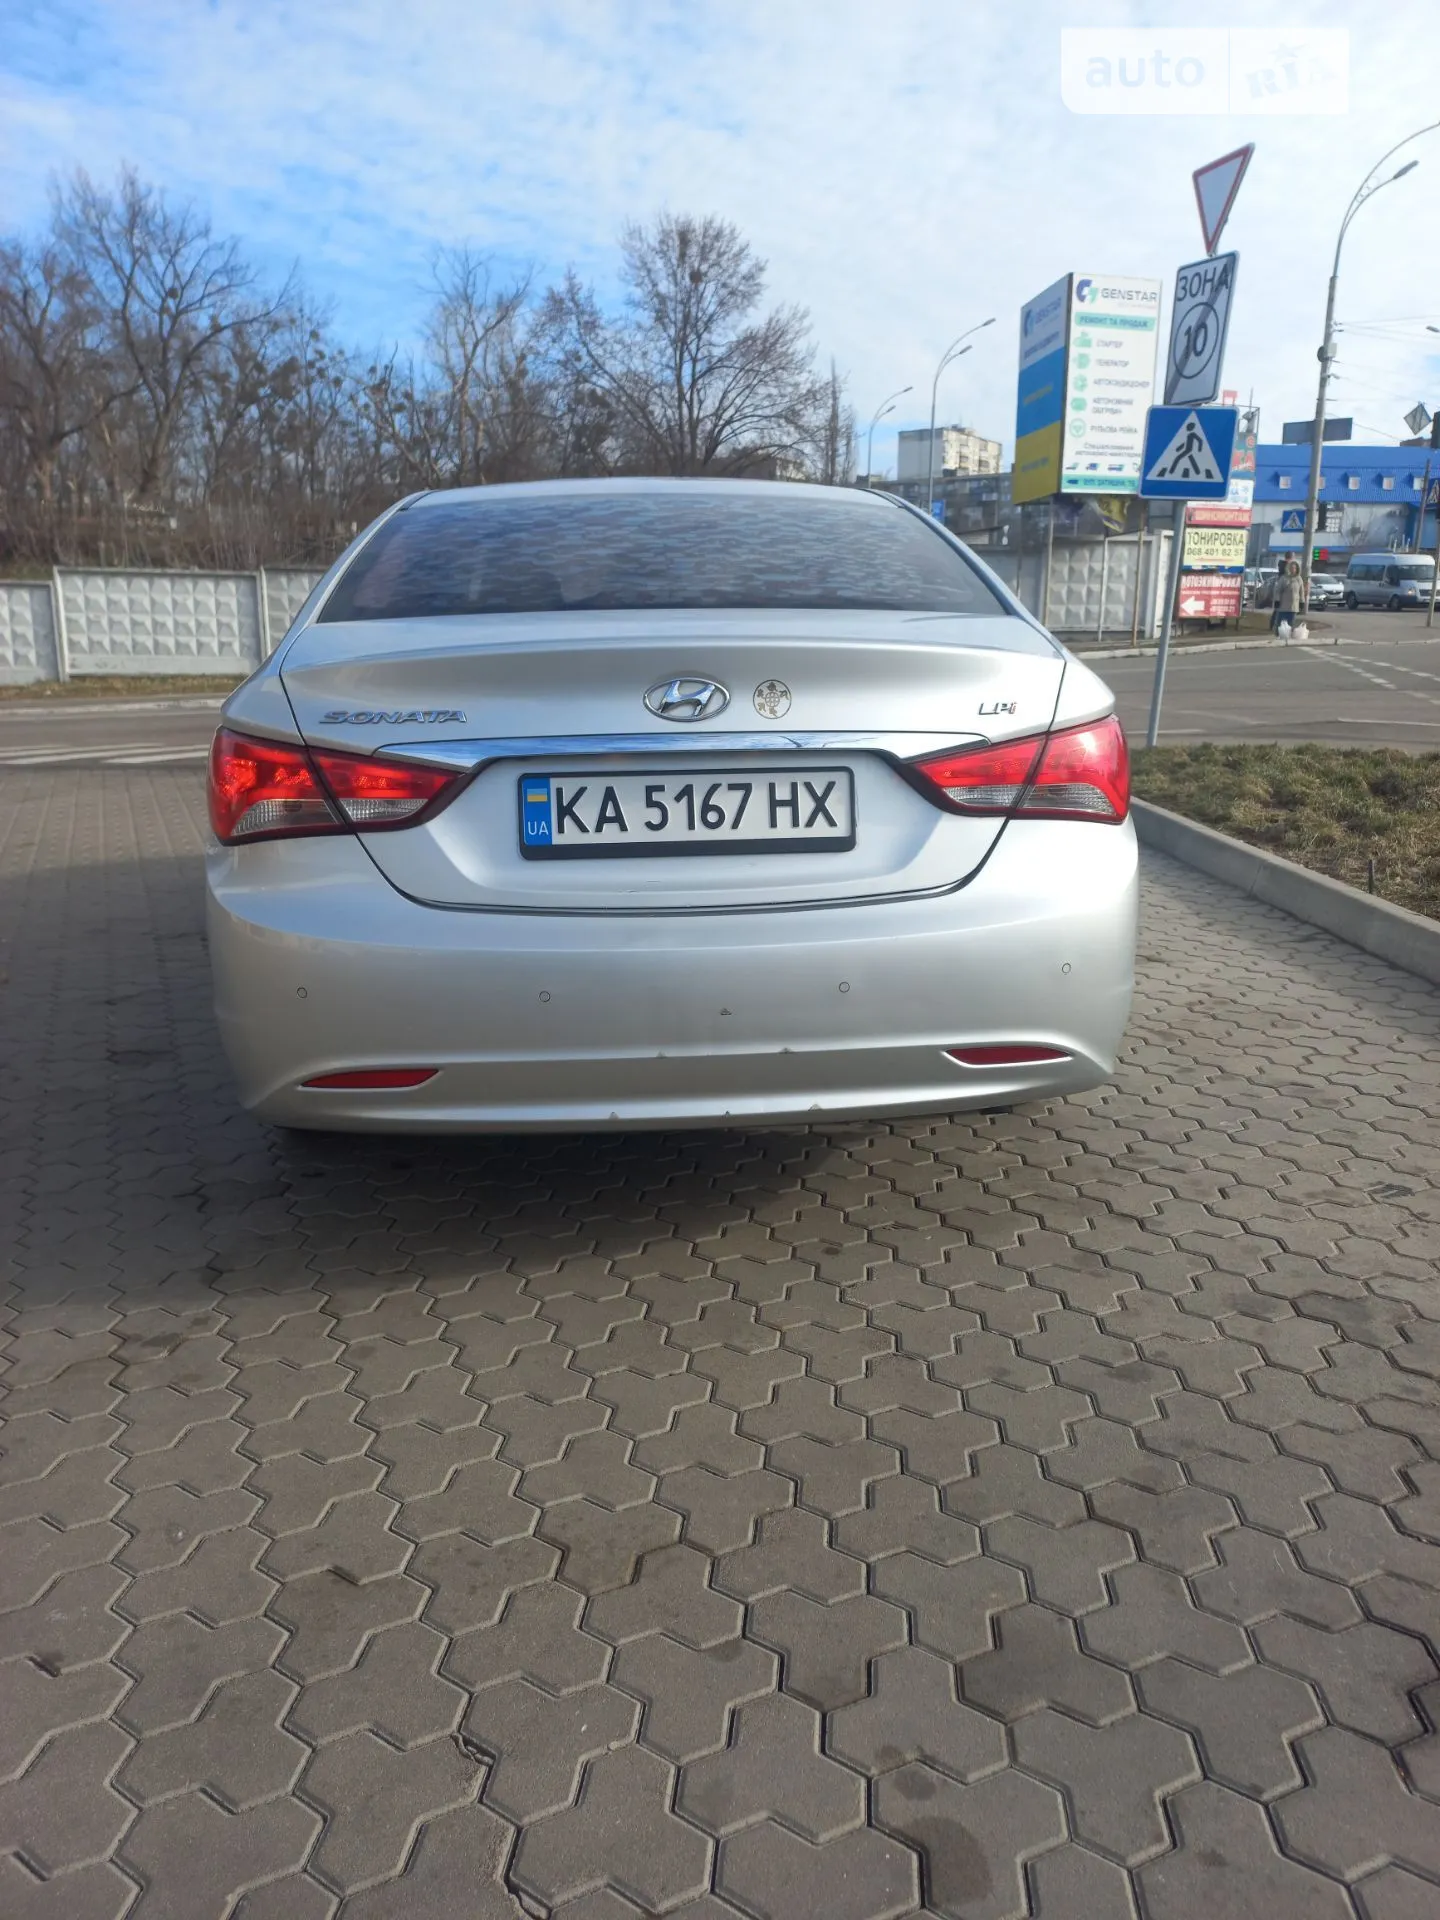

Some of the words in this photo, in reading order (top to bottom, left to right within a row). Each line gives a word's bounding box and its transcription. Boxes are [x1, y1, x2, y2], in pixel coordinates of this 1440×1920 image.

[1101, 287, 1158, 302] GENSTAR
[1176, 263, 1229, 302] ЗОНА
[1183, 321, 1208, 361] 10
[1187, 531, 1244, 546] ТОНИРОВКА
[319, 710, 468, 724] SONATA
[527, 821, 549, 836] UA
[556, 786, 629, 834] KA
[644, 782, 753, 831] 5167
[768, 780, 839, 829] HX
